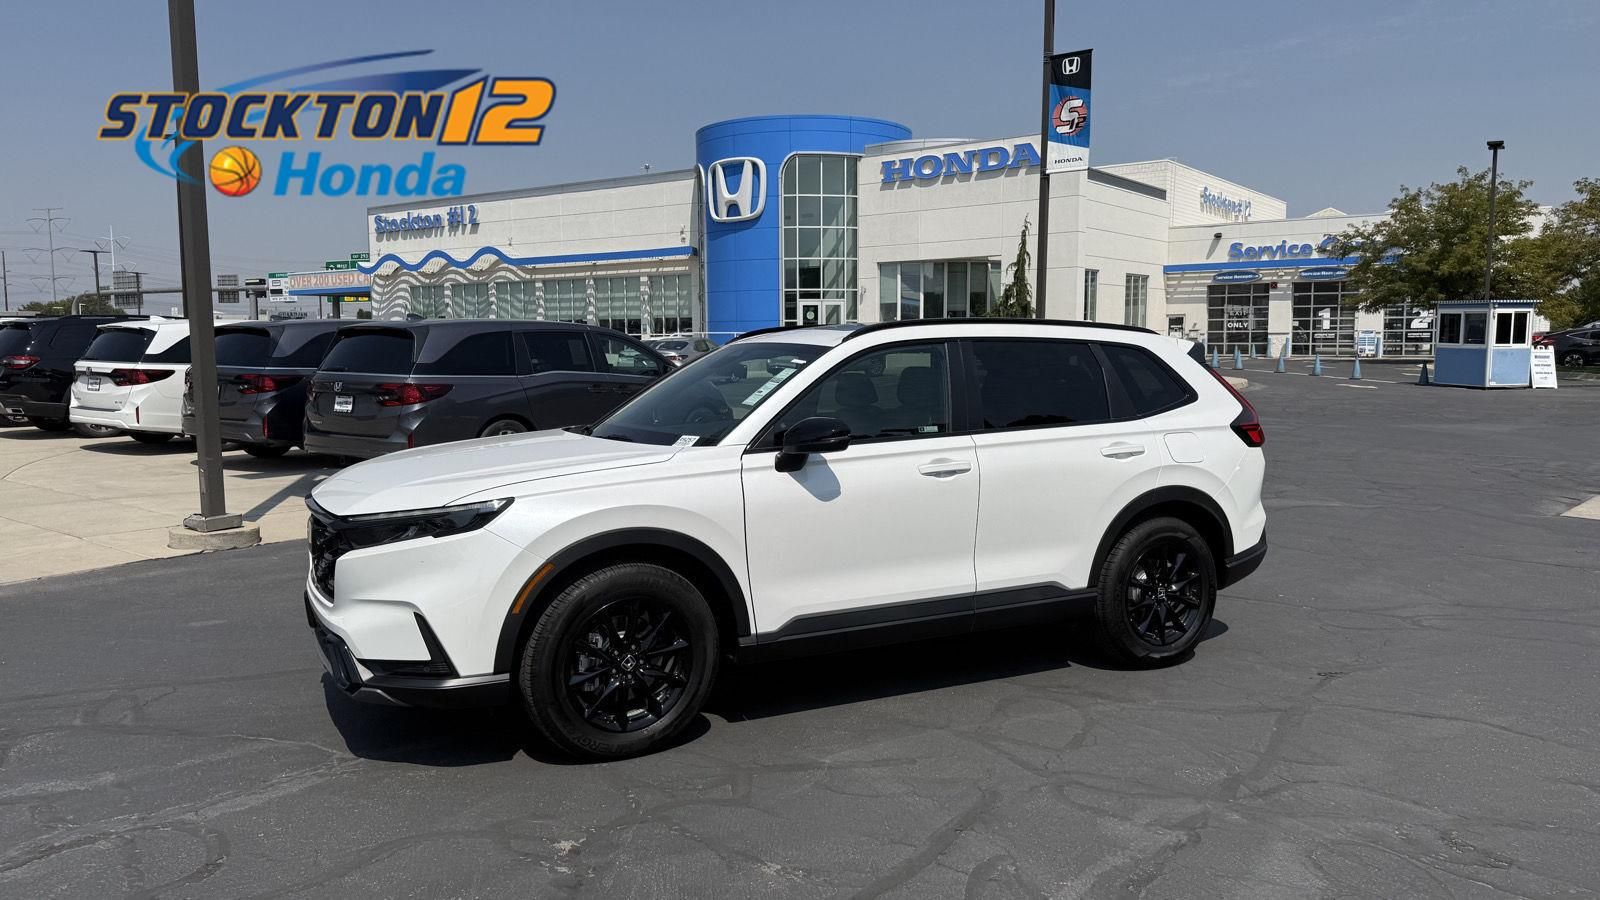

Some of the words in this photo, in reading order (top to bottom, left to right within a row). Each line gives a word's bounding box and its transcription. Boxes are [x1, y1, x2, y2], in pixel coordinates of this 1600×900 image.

[881, 142, 1041, 183] HONDA
[374, 212, 442, 233] Stockton
[447, 204, 478, 225] #12
[1229, 239, 1313, 259] Service
[289, 276, 312, 288] OVER
[313, 275, 329, 287] 200
[330, 273, 355, 286] USED
[1318, 308, 1330, 329] 1
[1410, 306, 1428, 329] 2
